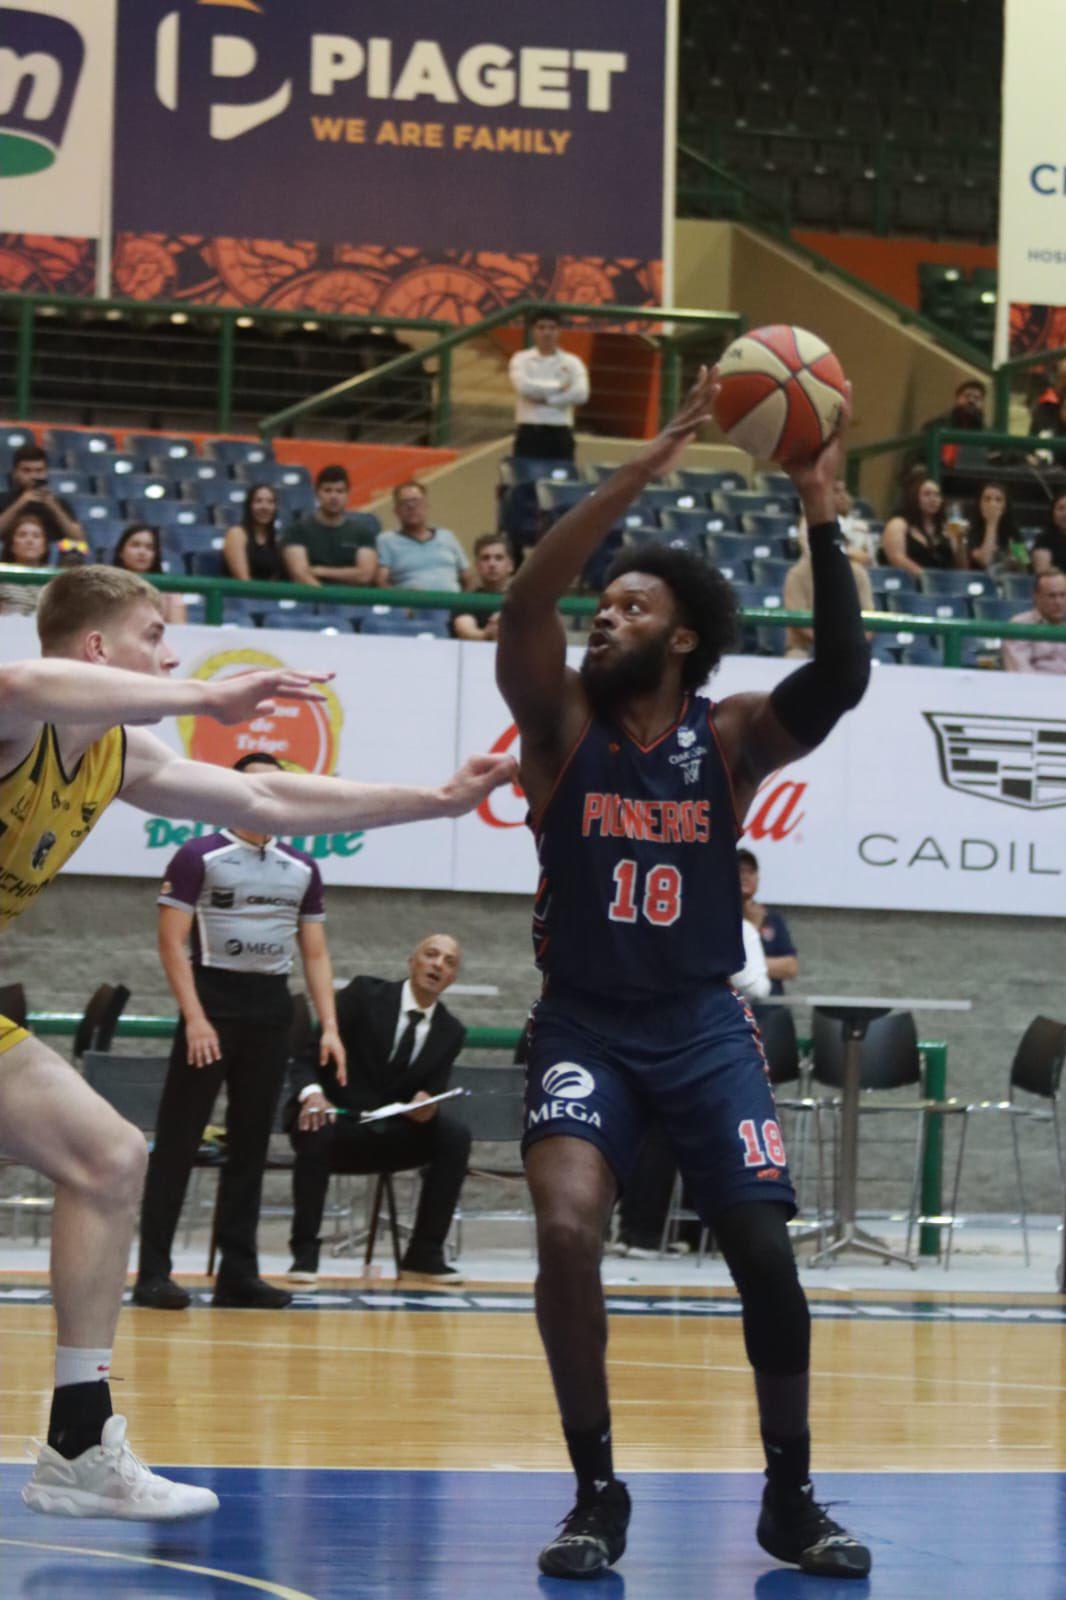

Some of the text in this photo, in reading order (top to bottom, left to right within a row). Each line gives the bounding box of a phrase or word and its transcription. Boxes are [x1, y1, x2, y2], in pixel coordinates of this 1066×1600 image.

[310, 34, 627, 112] PIAGET
[310, 116, 571, 155] WE ARE FAMILY
[608, 859, 682, 927] 18
[527, 1099, 602, 1129] MEGA
[738, 1119, 786, 1167] 18
